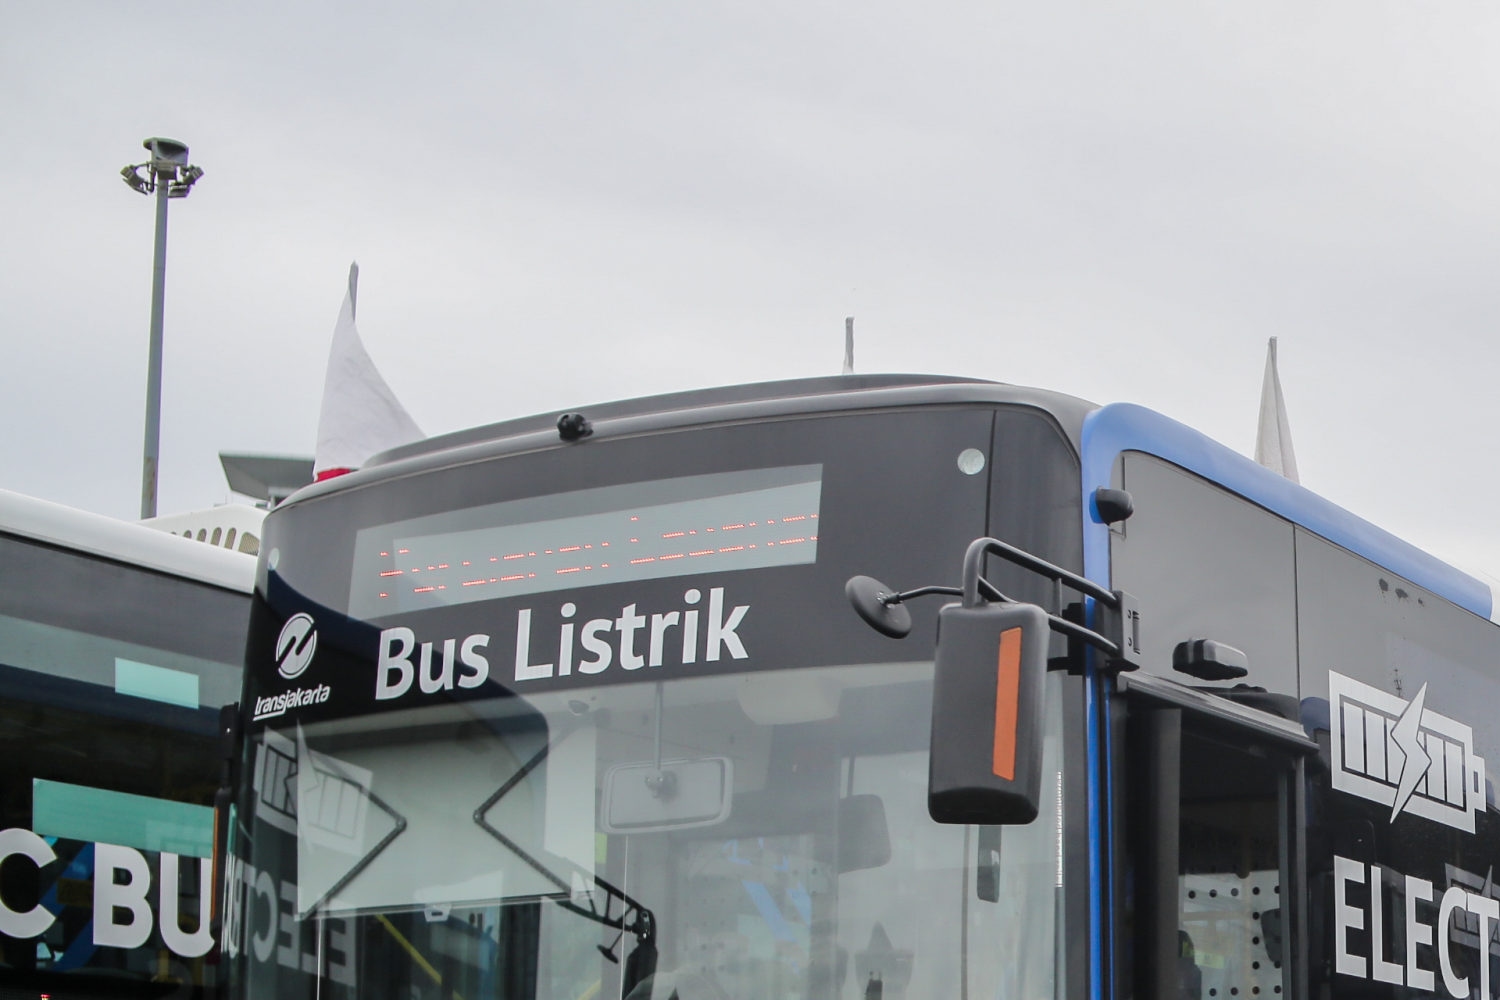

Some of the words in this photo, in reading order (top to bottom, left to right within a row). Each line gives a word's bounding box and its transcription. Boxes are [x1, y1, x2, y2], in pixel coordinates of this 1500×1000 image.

[375, 626, 490, 700] Bus
[515, 586, 751, 682] Listrik
[253, 683, 331, 721] transjakarta
[92, 841, 216, 958] BU
